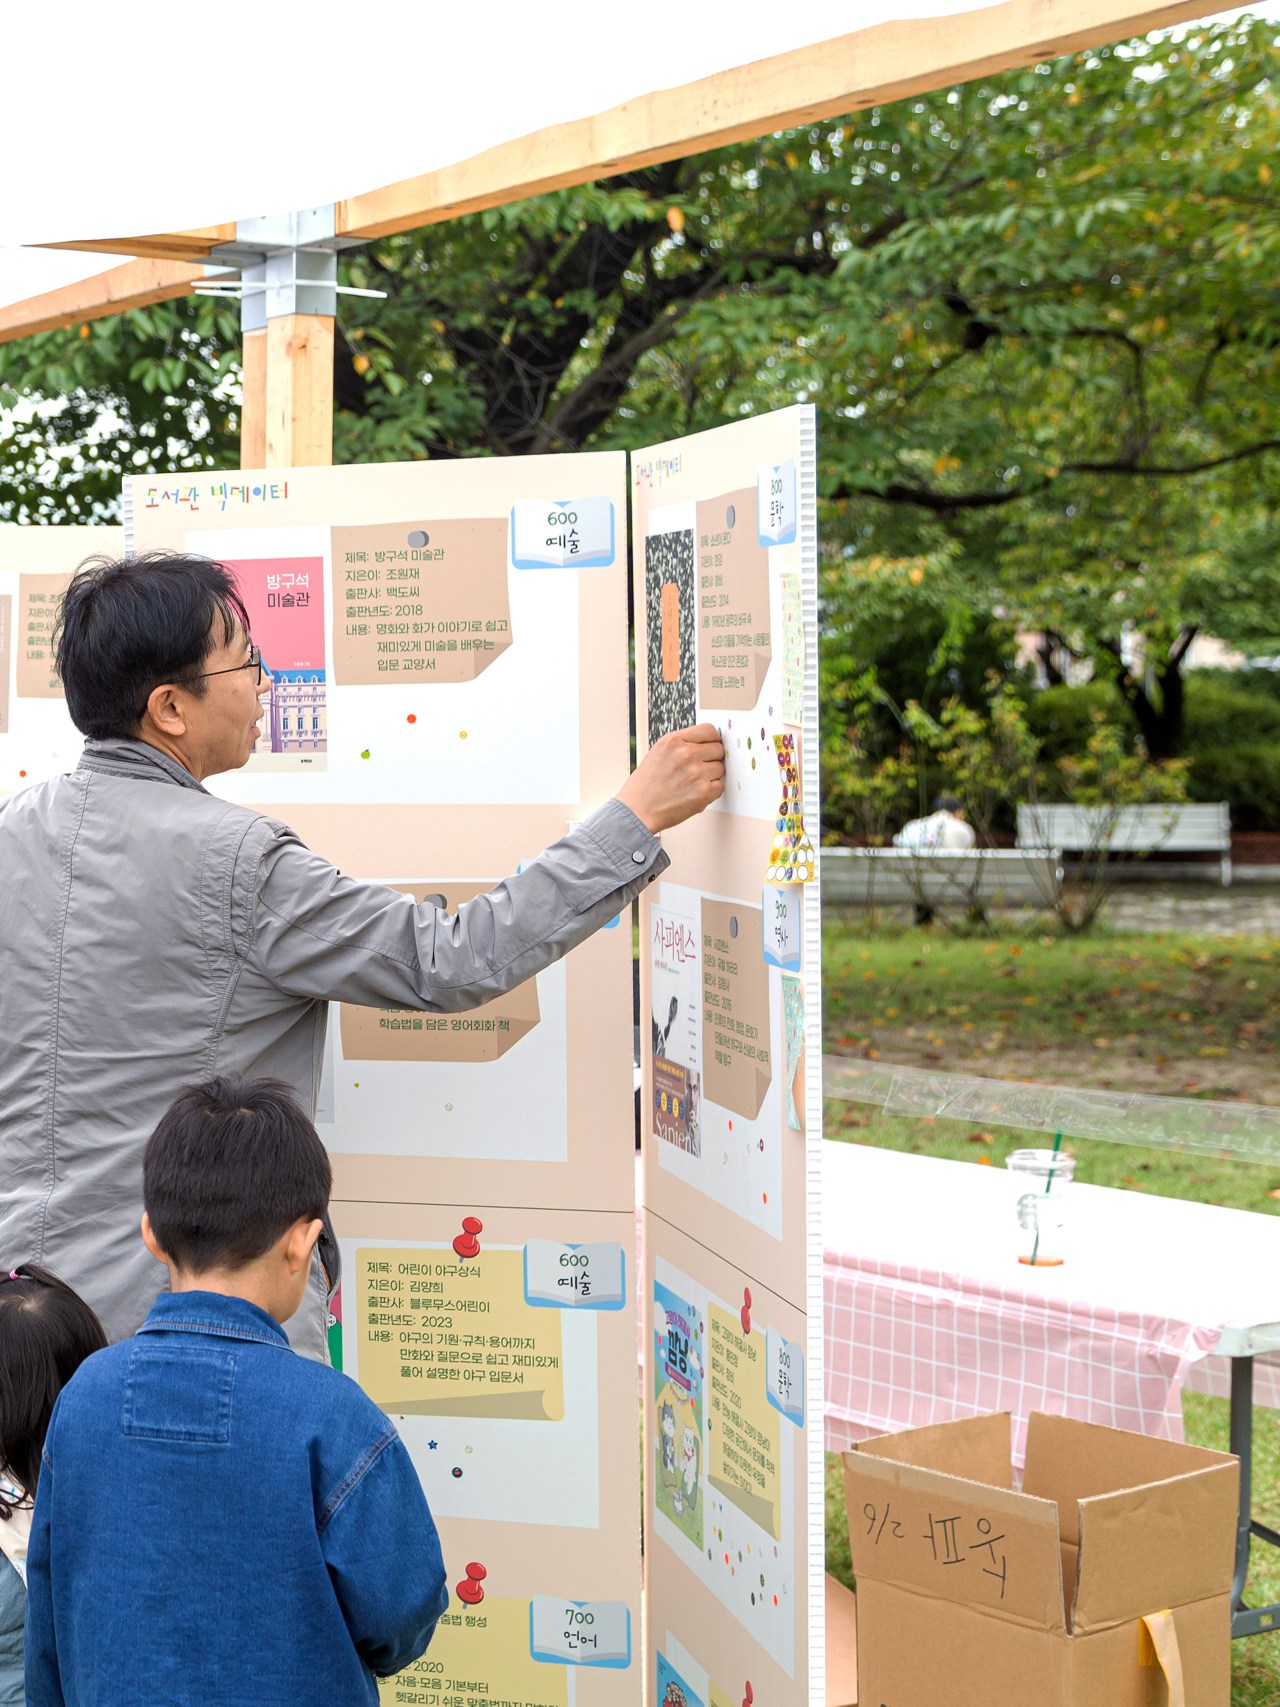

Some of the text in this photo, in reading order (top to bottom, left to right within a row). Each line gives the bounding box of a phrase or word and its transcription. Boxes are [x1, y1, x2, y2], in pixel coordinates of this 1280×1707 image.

[771, 479, 782, 495] 800
[146, 482, 289, 511] 도서관 빅데이터
[547, 512, 577, 526] 600
[770, 501, 784, 527] 문학
[546, 529, 580, 553] 예술
[345, 549, 445, 564] 제목: 방구석 미술관
[266, 573, 310, 590] 방구석
[345, 568, 420, 582] 지은이: 조원재
[267, 592, 311, 608] 미술관
[345, 586, 420, 600] 출판사: 백도씨
[346, 604, 423, 618] 출판년도: 2018
[346, 619, 508, 636] 내용: 명화와 화가 이야기로 쉽고
[377, 638, 495, 653] 재미있게 미술을 배우는
[377, 658, 436, 671] 입문 교양서
[775, 901, 786, 919] 900
[654, 917, 697, 963] 사피엔스
[775, 927, 788, 949] 역사
[379, 1018, 510, 1032] 학습법을 담은 영어회화 책
[559, 1253, 589, 1268] 600
[367, 1262, 481, 1278] 제목: 어린이 야구상식
[367, 1279, 444, 1294] 지은이: 김양희
[557, 1270, 591, 1296] 예술
[368, 1296, 490, 1313] 출판사: 블루무스어린이
[368, 1313, 452, 1328] 출판년도: 2023
[368, 1330, 394, 1343] 내용:
[399, 1331, 433, 1345] 야구의
[400, 1349, 559, 1368] 만화와 질문으로 쉽고 재미있게
[400, 1366, 524, 1384] 풀어 설명한 야구 입문서
[437, 1614, 487, 1628] 춤법 행성
[565, 1609, 594, 1625] 700
[563, 1630, 597, 1649] 언어
[414, 1660, 444, 1673] 2020
[445, 1679, 489, 1694] 기본부터
[395, 1691, 440, 1706] 헷갈리기
[443, 1692, 464, 1706] 쉬운
